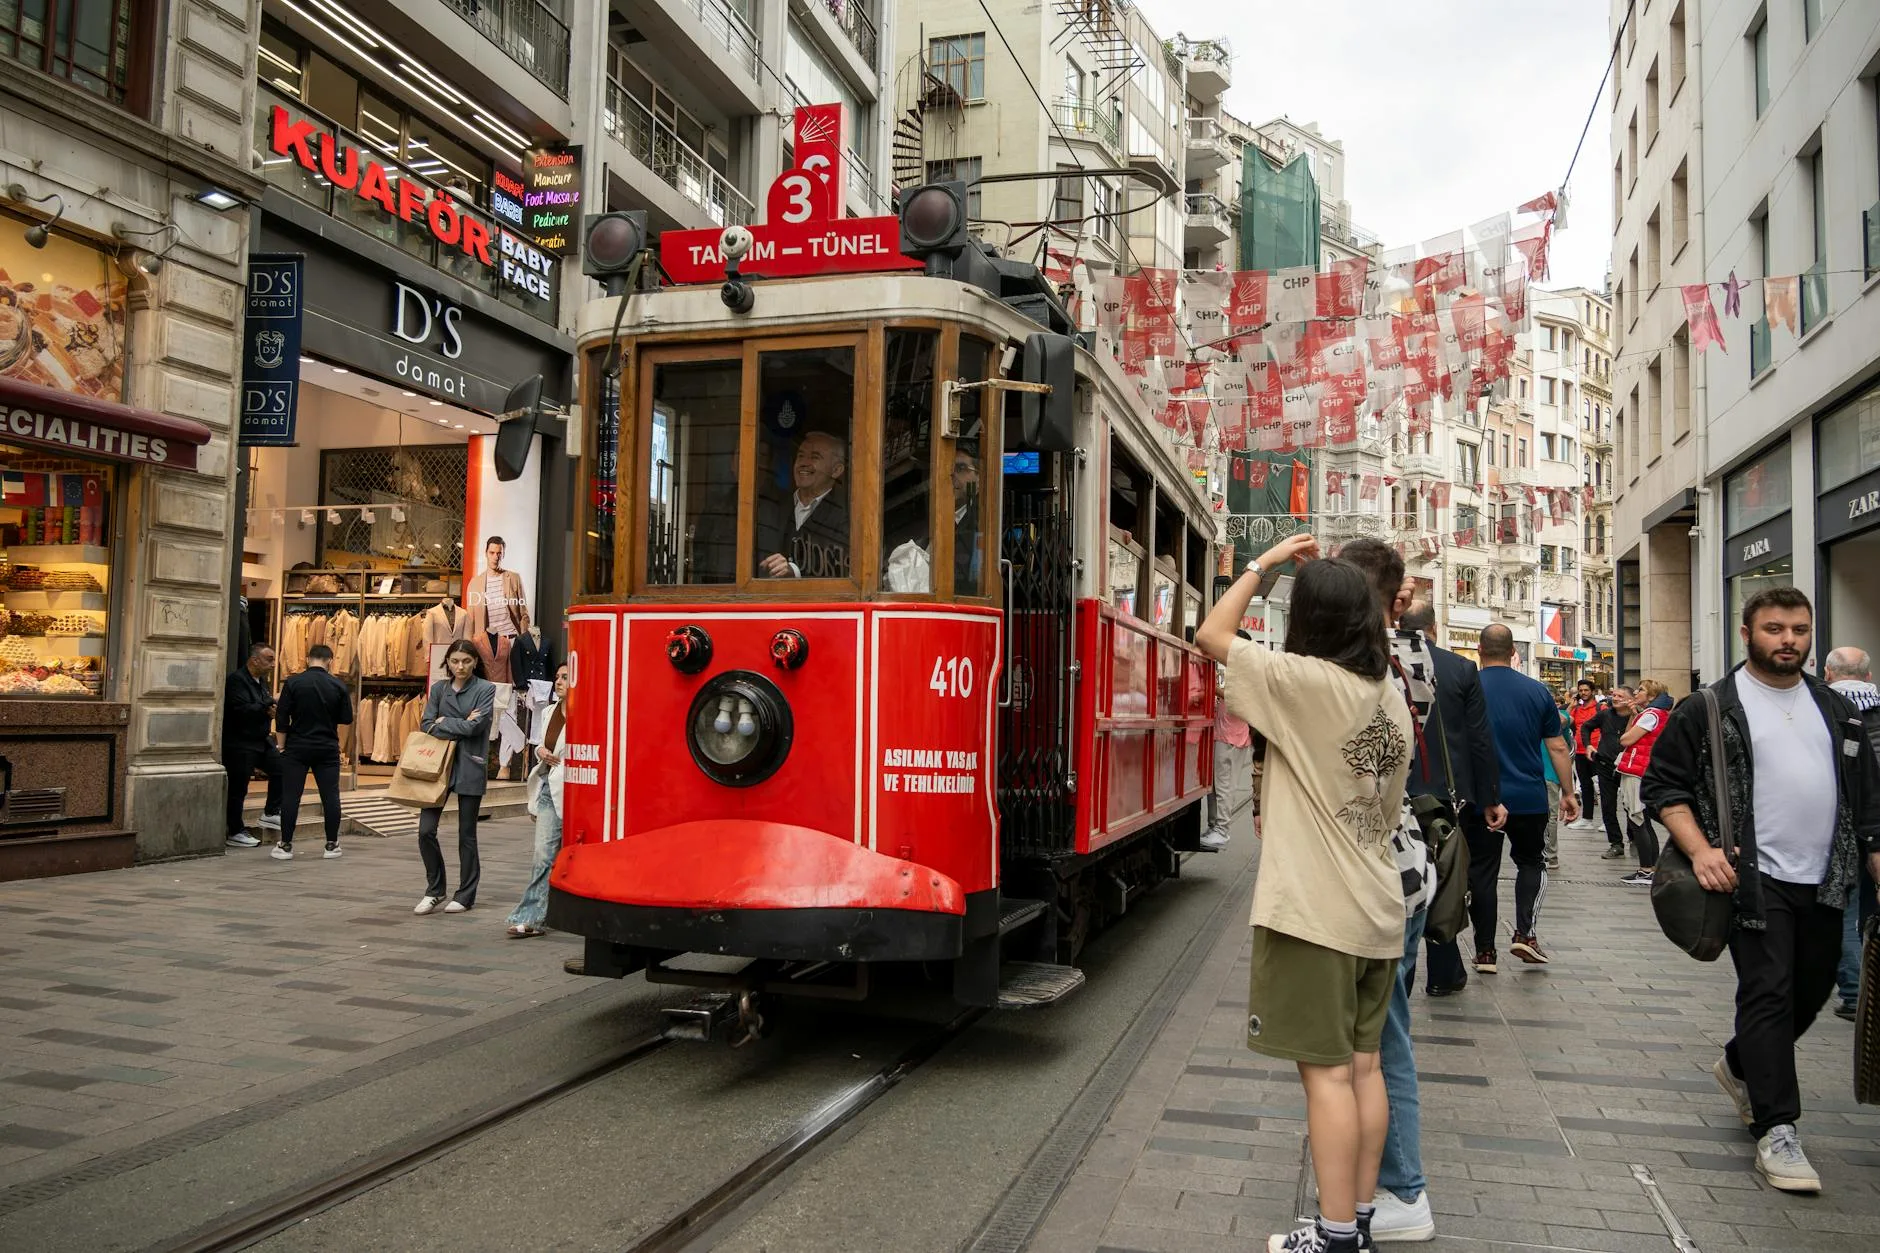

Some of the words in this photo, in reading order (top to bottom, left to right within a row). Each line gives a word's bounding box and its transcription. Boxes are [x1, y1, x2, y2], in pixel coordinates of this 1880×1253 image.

[534, 150, 574, 167] Extension
[271, 105, 492, 267] KUAFÖR
[533, 170, 572, 187] Manicure
[525, 191, 544, 207] Foot
[546, 191, 580, 207] Massage
[781, 176, 812, 223] 3
[533, 211, 569, 229] Pedicure
[808, 231, 888, 257] TÜNEL
[502, 232, 553, 277] BABY
[503, 260, 550, 301] FACE
[1283, 277, 1310, 289] CHP
[251, 297, 292, 307] damat
[1236, 304, 1261, 316] CHP
[394, 282, 462, 359] D'S
[1196, 310, 1219, 320] CHP
[1379, 346, 1402, 360] CHP
[1164, 360, 1185, 369] CHP
[1251, 362, 1267, 371] HP
[396, 355, 466, 398] damat
[1342, 379, 1364, 387] CHP
[1285, 394, 1305, 402] CHP
[1322, 398, 1343, 408] CHP
[244, 416, 285, 425] damat
[1263, 422, 1282, 430] CHP
[1293, 421, 1312, 430] CHP
[1848, 490, 1880, 518] ZAR
[1744, 538, 1771, 561] ZARA
[930, 656, 973, 698] 410
[884, 748, 942, 769] ASILMAK
[946, 751, 977, 770] YASAK
[884, 773, 899, 792] VE
[903, 772, 975, 793] TEHLİKELİDİR
